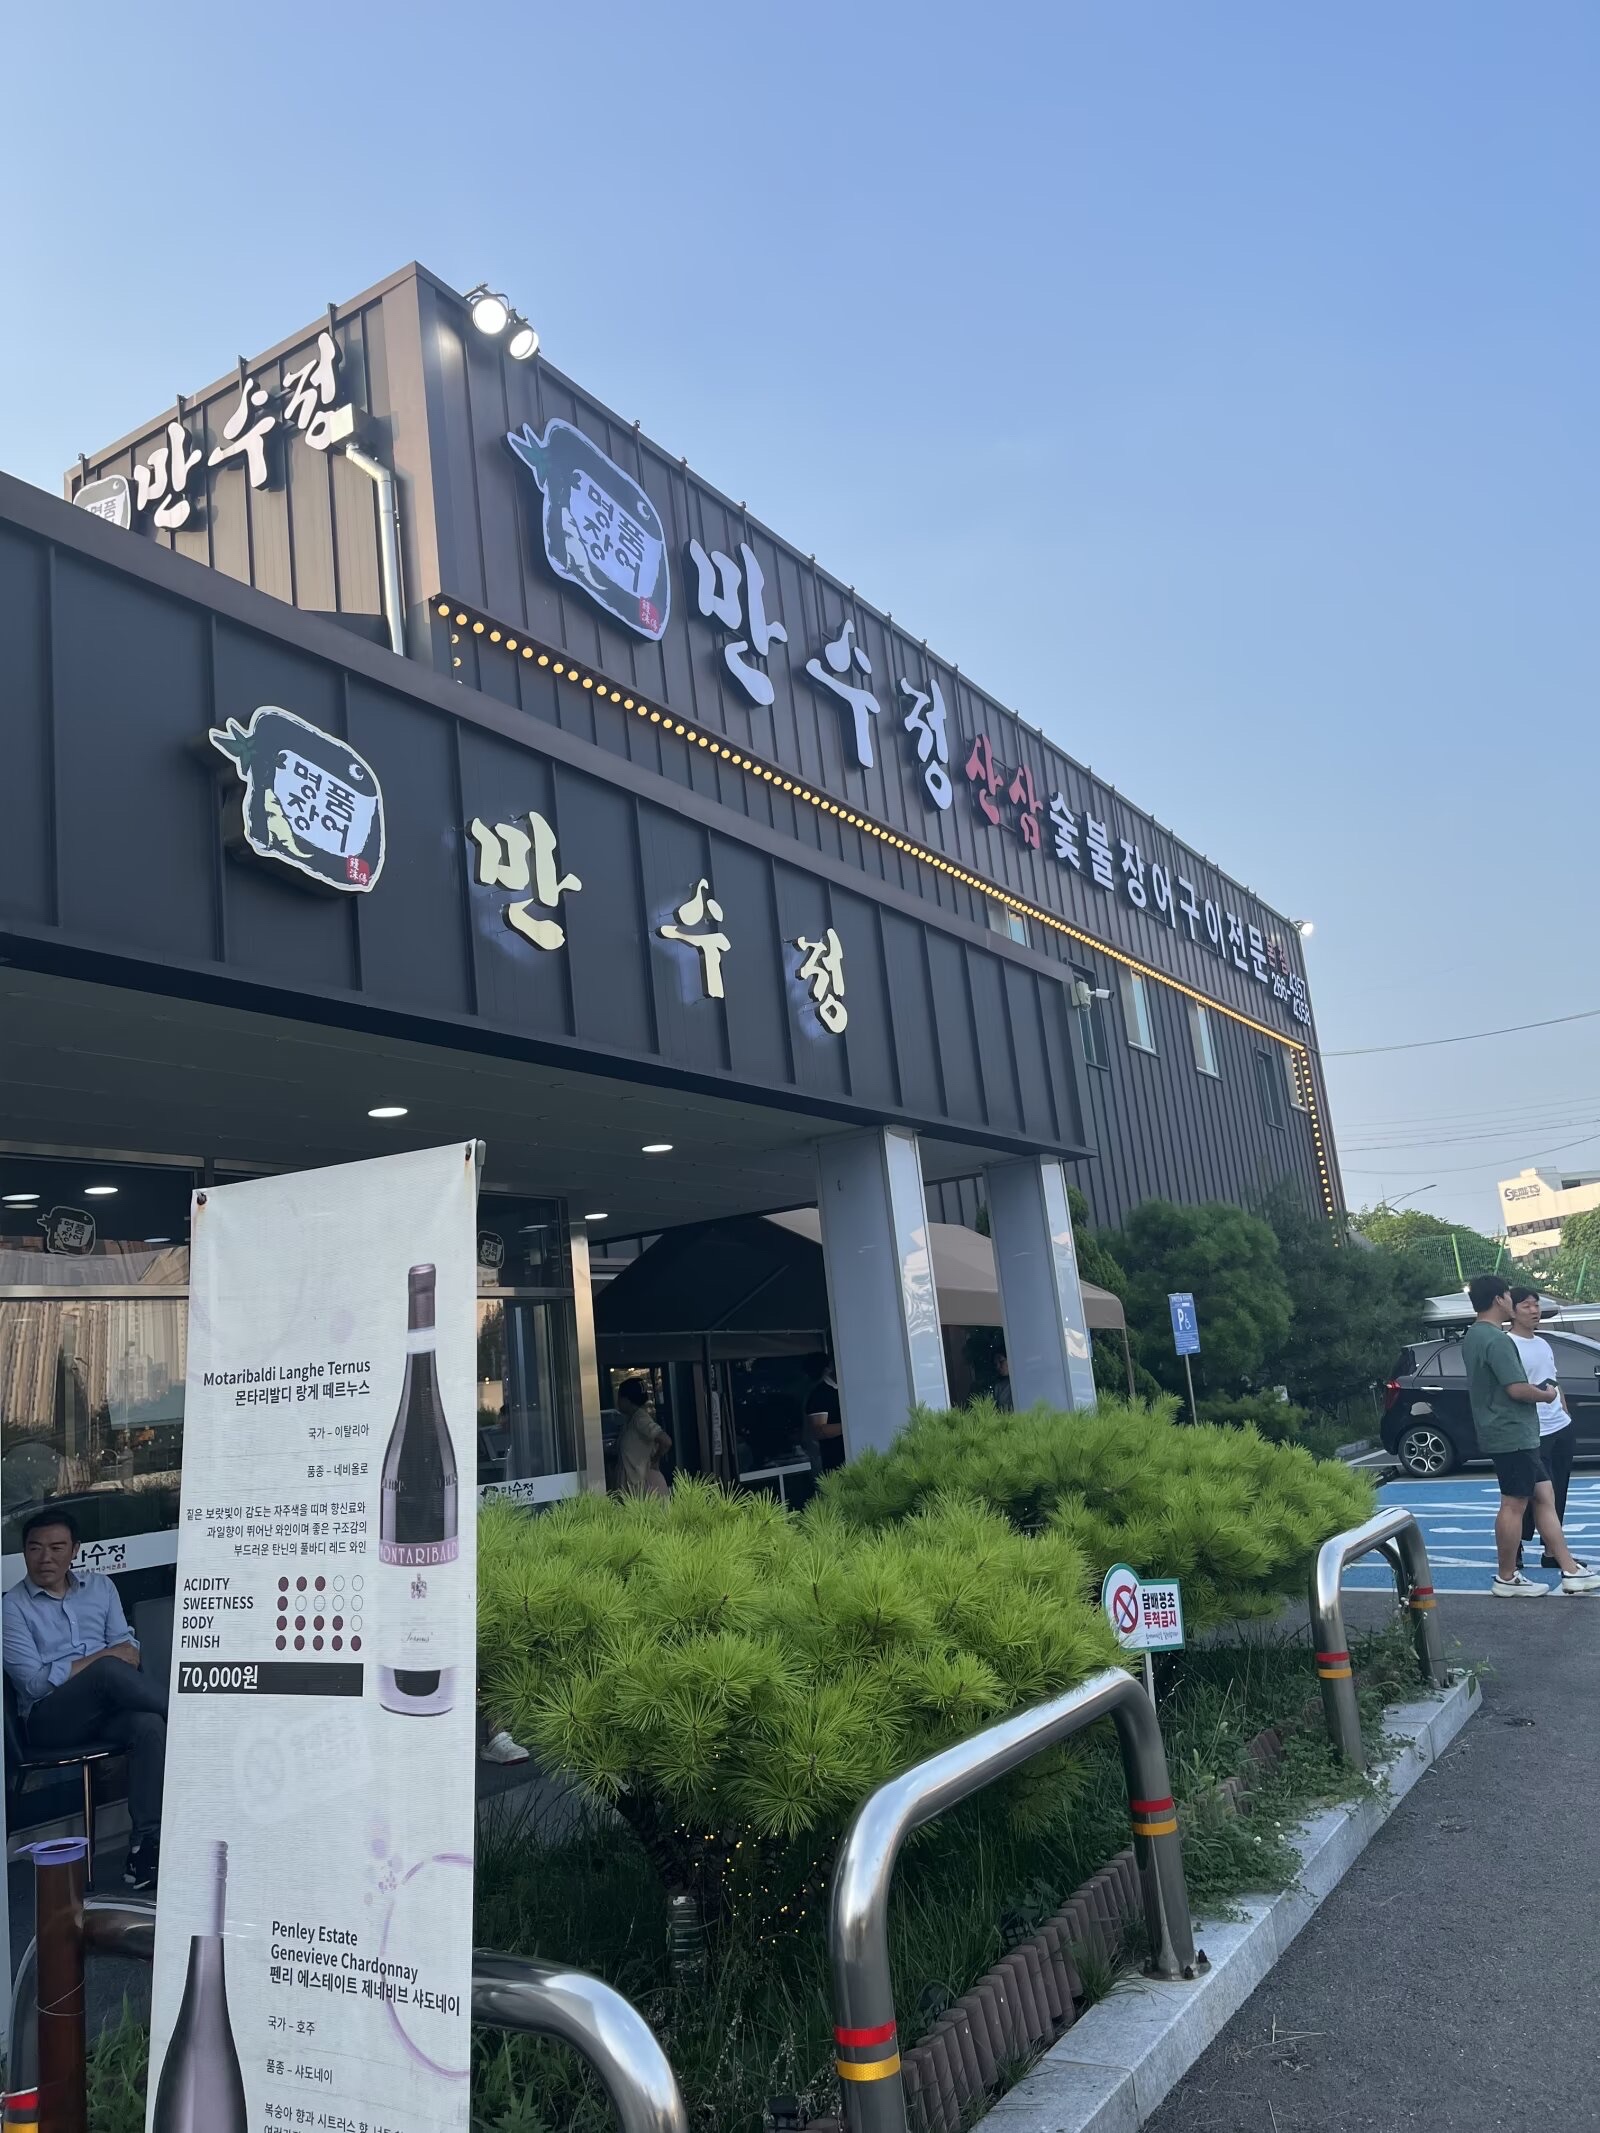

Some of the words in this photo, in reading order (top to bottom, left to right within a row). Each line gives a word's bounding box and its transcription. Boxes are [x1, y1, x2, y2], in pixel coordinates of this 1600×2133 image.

[133, 332, 336, 529] 만수정
[588, 484, 645, 563] 명품
[583, 514, 641, 592] 장어
[689, 538, 953, 811] 만수정
[965, 733, 1044, 849] 산삼
[1049, 791, 1269, 985] 숯불장어구이전문
[294, 741, 356, 823] 명품
[287, 792, 350, 853] 장어
[465, 811, 849, 1034] 만수정
[203, 1366, 276, 1386] Motaribaldi
[279, 1362, 324, 1382] Langhe
[327, 1360, 371, 1376] Ternus
[235, 1385, 292, 1406] 몬타리발디
[296, 1383, 319, 1401] 랑게
[322, 1380, 371, 1399] 떼르누스
[308, 1427, 326, 1439] 국가
[334, 1423, 369, 1438] 이탈리아
[307, 1465, 324, 1478] 품종
[333, 1463, 369, 1477] 네비올로
[205, 1506, 242, 1520] 보랏빛이
[245, 1505, 271, 1519] 감도는
[273, 1503, 308, 1517] 자주색을
[310, 1502, 328, 1516] 띠며
[330, 1501, 366, 1515] 향신료와
[206, 1525, 243, 1539] 과일향이
[246, 1524, 273, 1538] 뛰어난
[275, 1522, 309, 1537] 와인이며
[312, 1522, 330, 1536] 좋은
[332, 1520, 367, 1535] 구조감의
[234, 1543, 269, 1557] 부드러운
[272, 1542, 298, 1556] 탄닌의
[300, 1541, 326, 1556] 풀바디
[329, 1541, 347, 1555] 레드
[349, 1540, 367, 1554] 와인
[183, 1577, 230, 1591] ACIDITY
[183, 1596, 254, 1610] SWEETNESS
[182, 1616, 214, 1629] BODY
[1144, 1610, 1177, 1629] 투척금지
[181, 1635, 220, 1649] FINISH
[181, 1664, 258, 1692] 70,000원
[272, 1920, 315, 1944] Penley
[318, 1926, 358, 1946] Estate
[270, 1944, 338, 1967] Genevieve
[341, 1952, 418, 1985] Chardonnay
[269, 1965, 293, 1986] 펜리
[297, 1969, 358, 1994] 에스테이트
[361, 1979, 409, 2004] 제네비브
[412, 1988, 460, 2016] 샤도네이
[268, 2015, 286, 2031] 국가
[296, 2020, 315, 2036] 호주
[266, 2058, 284, 2075] 품종
[295, 2064, 333, 2085] 샤도네이
[264, 2102, 292, 2121] 복숭아
[295, 2108, 315, 2126] 향과
[317, 2113, 355, 2133] 시트러스
